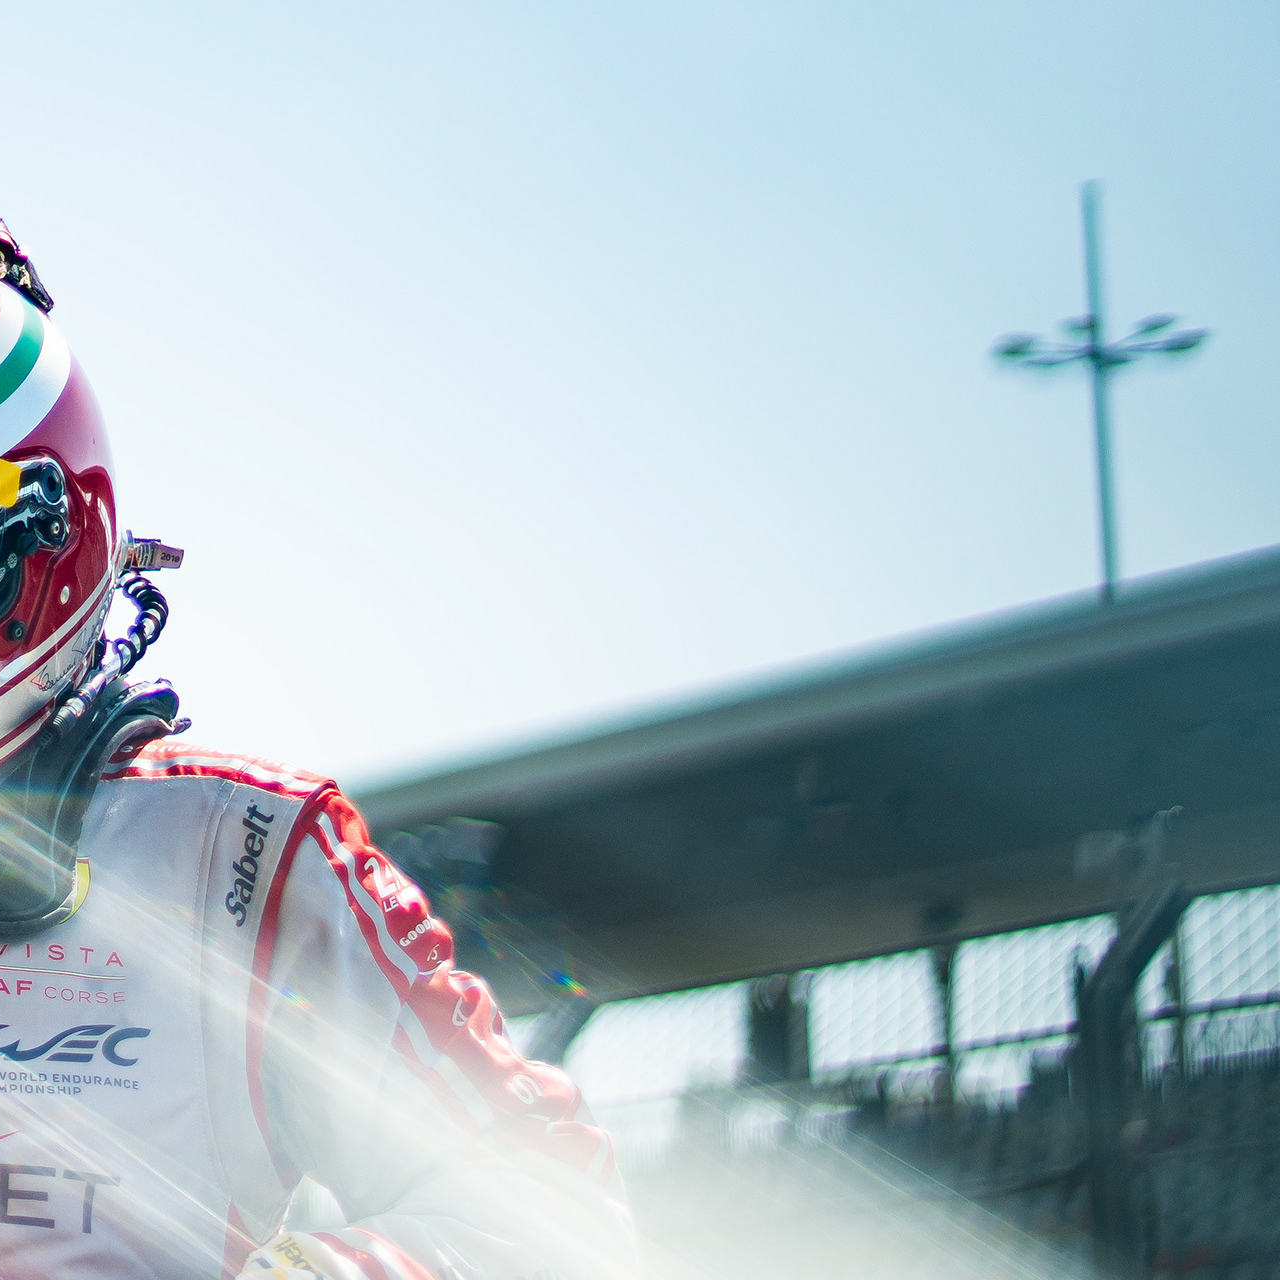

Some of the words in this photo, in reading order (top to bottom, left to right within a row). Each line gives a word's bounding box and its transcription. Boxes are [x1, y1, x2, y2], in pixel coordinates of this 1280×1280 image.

[225, 803, 275, 928] Sabelt
[43, 985, 126, 1004] CORSE
[52, 1073, 140, 1091] ENDURANCE
